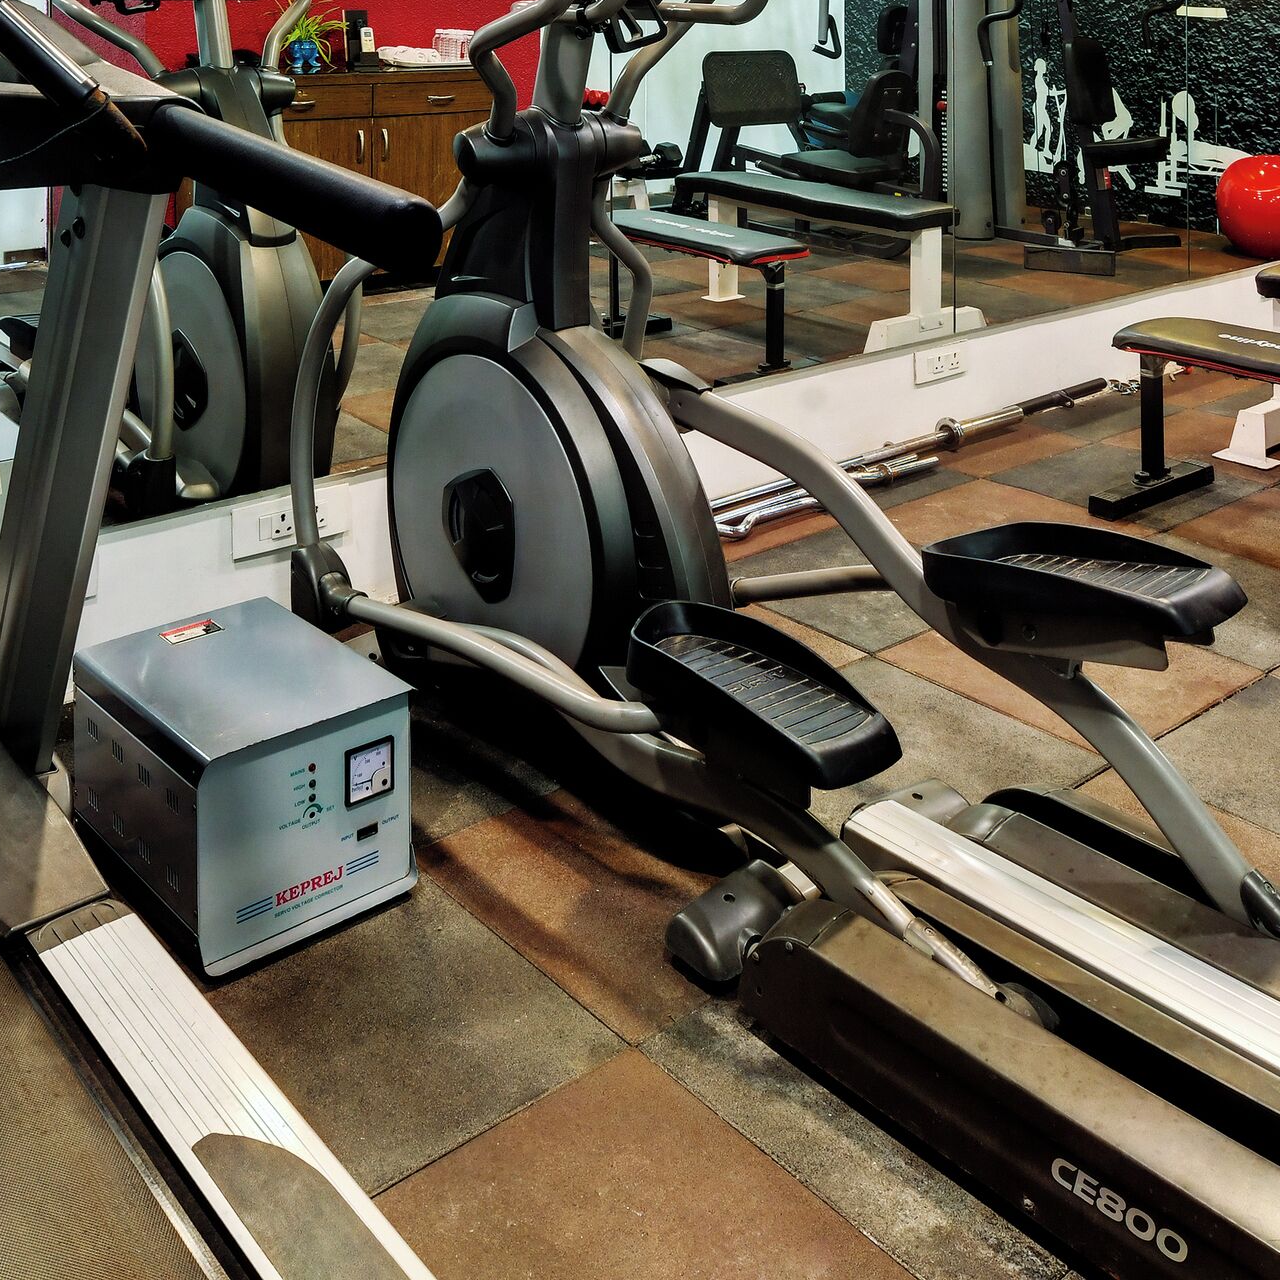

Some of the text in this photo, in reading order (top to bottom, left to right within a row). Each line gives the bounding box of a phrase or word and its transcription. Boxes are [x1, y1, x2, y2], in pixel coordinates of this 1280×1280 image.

[290, 768, 306, 777] MAINS
[279, 818, 301, 830] VOLTAGE
[301, 818, 321, 829] OUTPUT
[381, 814, 400, 825] OUTPUT
[340, 832, 354, 842] INPUT
[275, 865, 343, 907] KEPREJ
[274, 884, 343, 918] SERVO VOLTAGE CORRECTOR
[1051, 1157, 1188, 1263] CE800
